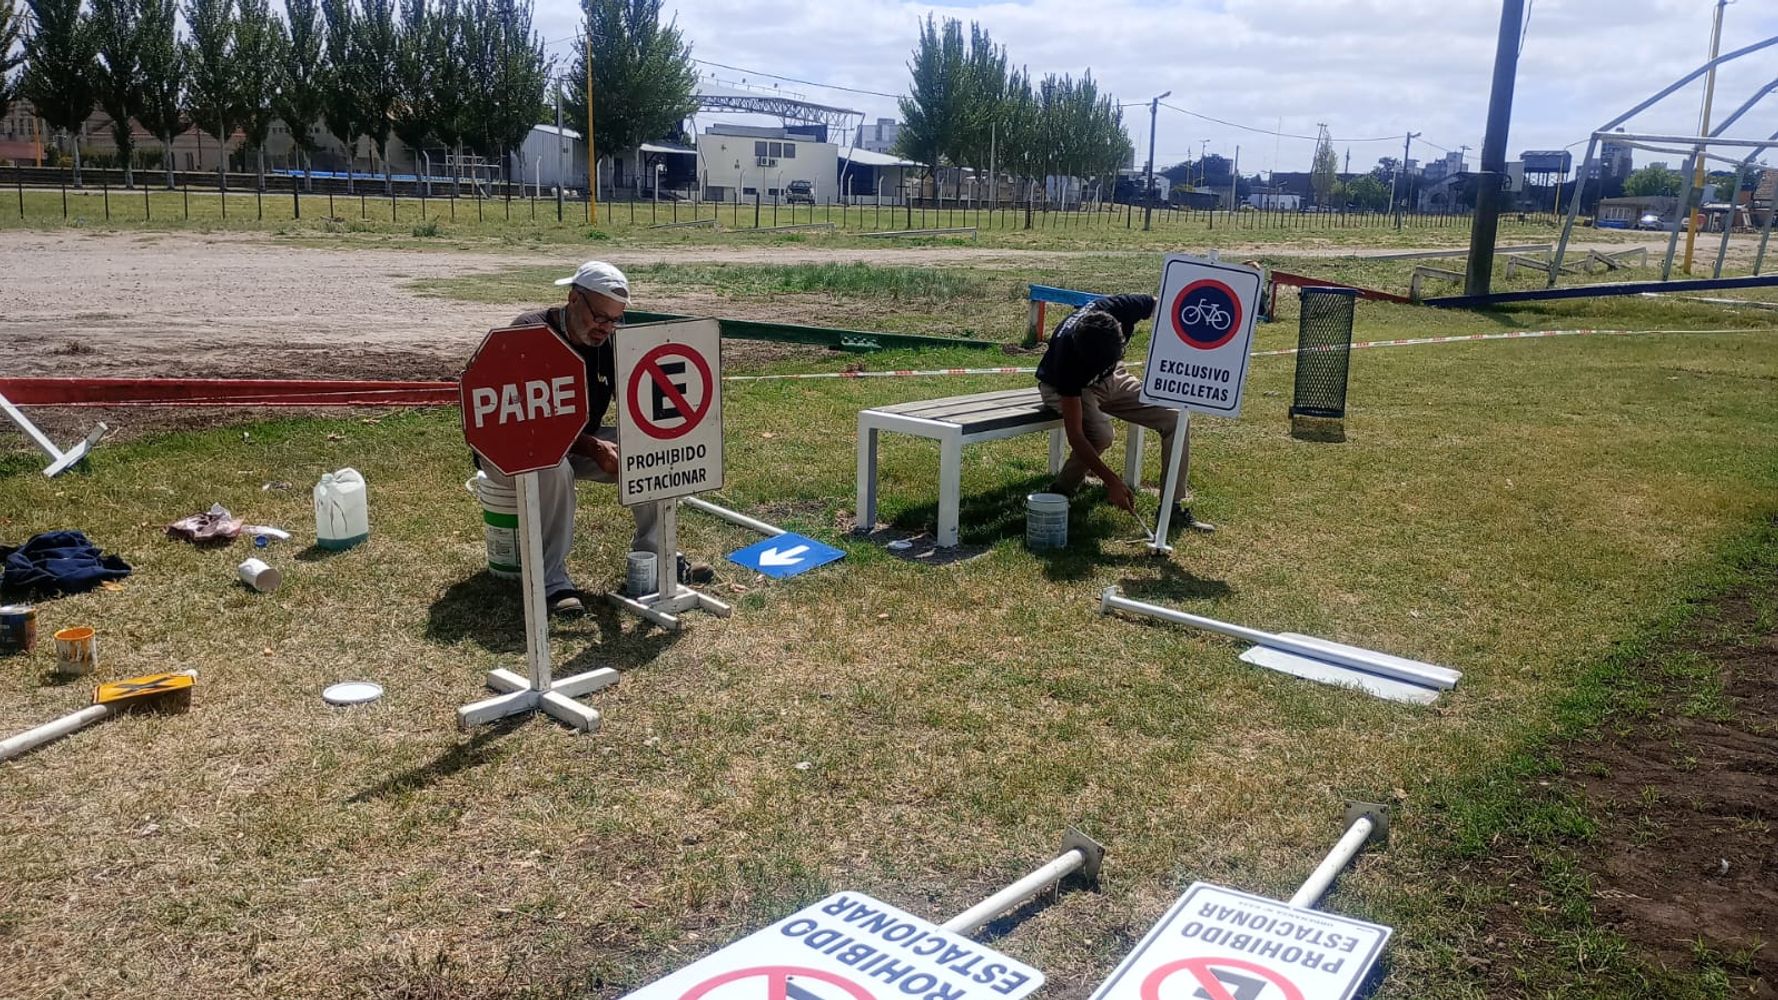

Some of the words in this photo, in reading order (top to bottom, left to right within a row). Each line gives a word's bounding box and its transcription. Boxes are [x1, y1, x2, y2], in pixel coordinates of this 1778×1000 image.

[652, 361, 687, 421] E
[1154, 378, 1228, 401] BICICLETAS
[1160, 359, 1230, 383] EXCLUSIVO
[472, 376, 576, 428] PARE
[627, 444, 707, 471] PROHIBIDO
[628, 467, 707, 494] ESTACIONAR
[821, 896, 1030, 995] ESTACIONAR
[1181, 921, 1346, 974] PROHIBIDO
[1199, 902, 1359, 953] ESTACIONAR
[781, 918, 965, 1000] ROHIBIDO
